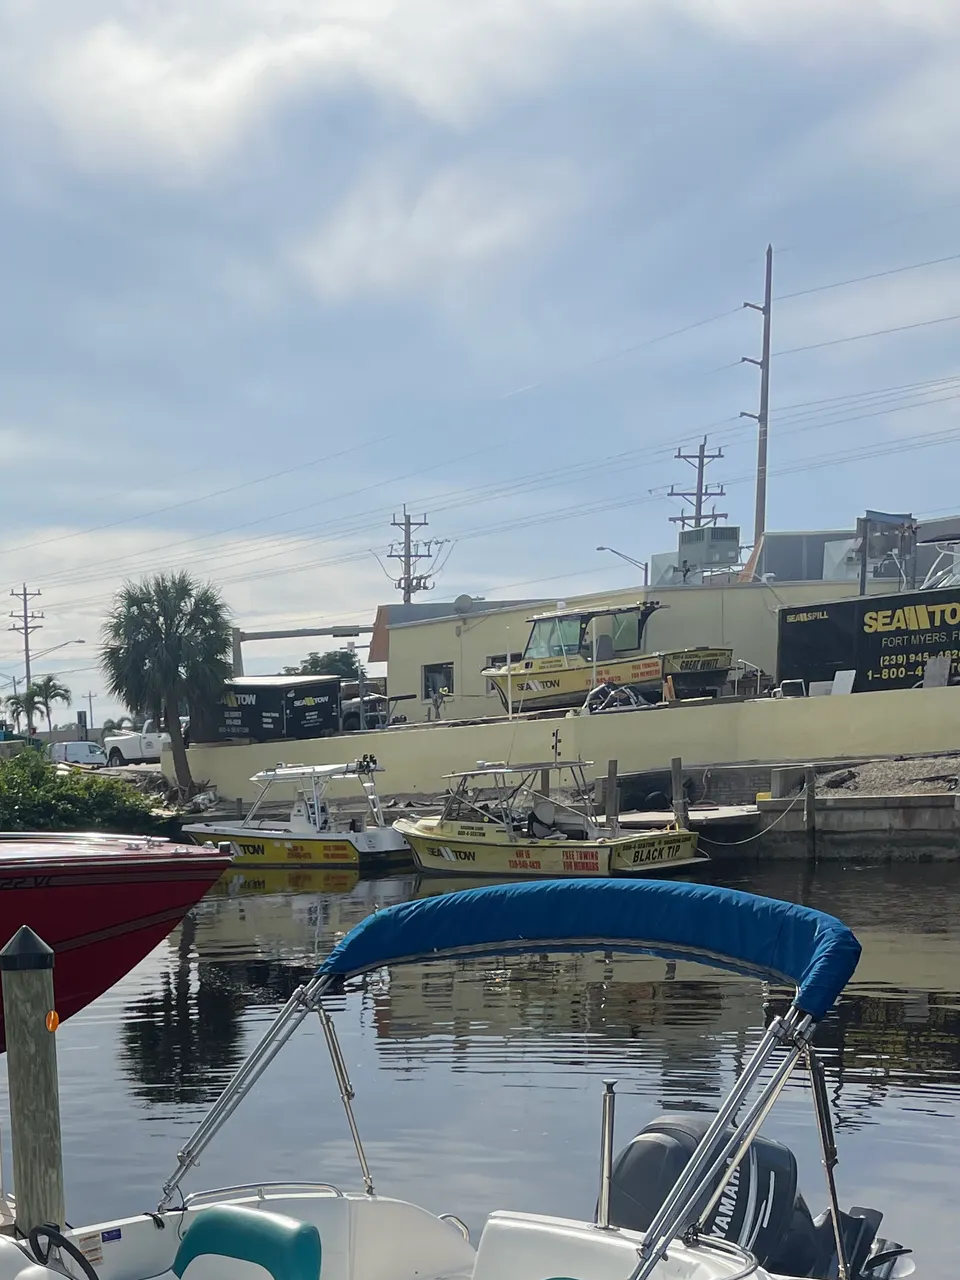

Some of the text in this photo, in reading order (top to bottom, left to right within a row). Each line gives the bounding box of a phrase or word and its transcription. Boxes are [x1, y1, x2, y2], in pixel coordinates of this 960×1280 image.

[786, 611, 829, 623] SEA SPILL
[863, 608, 907, 633] SEA
[881, 636, 909, 648] FORT
[880, 649, 960, 667] (239) 945-482
[516, 679, 560, 692] SEA TOW
[236, 694, 256, 705] TOW
[313, 696, 329, 704] TOW
[240, 844, 264, 855] TOW
[427, 847, 476, 861] SEA TOW
[633, 844, 680, 864] BLACK TIP
